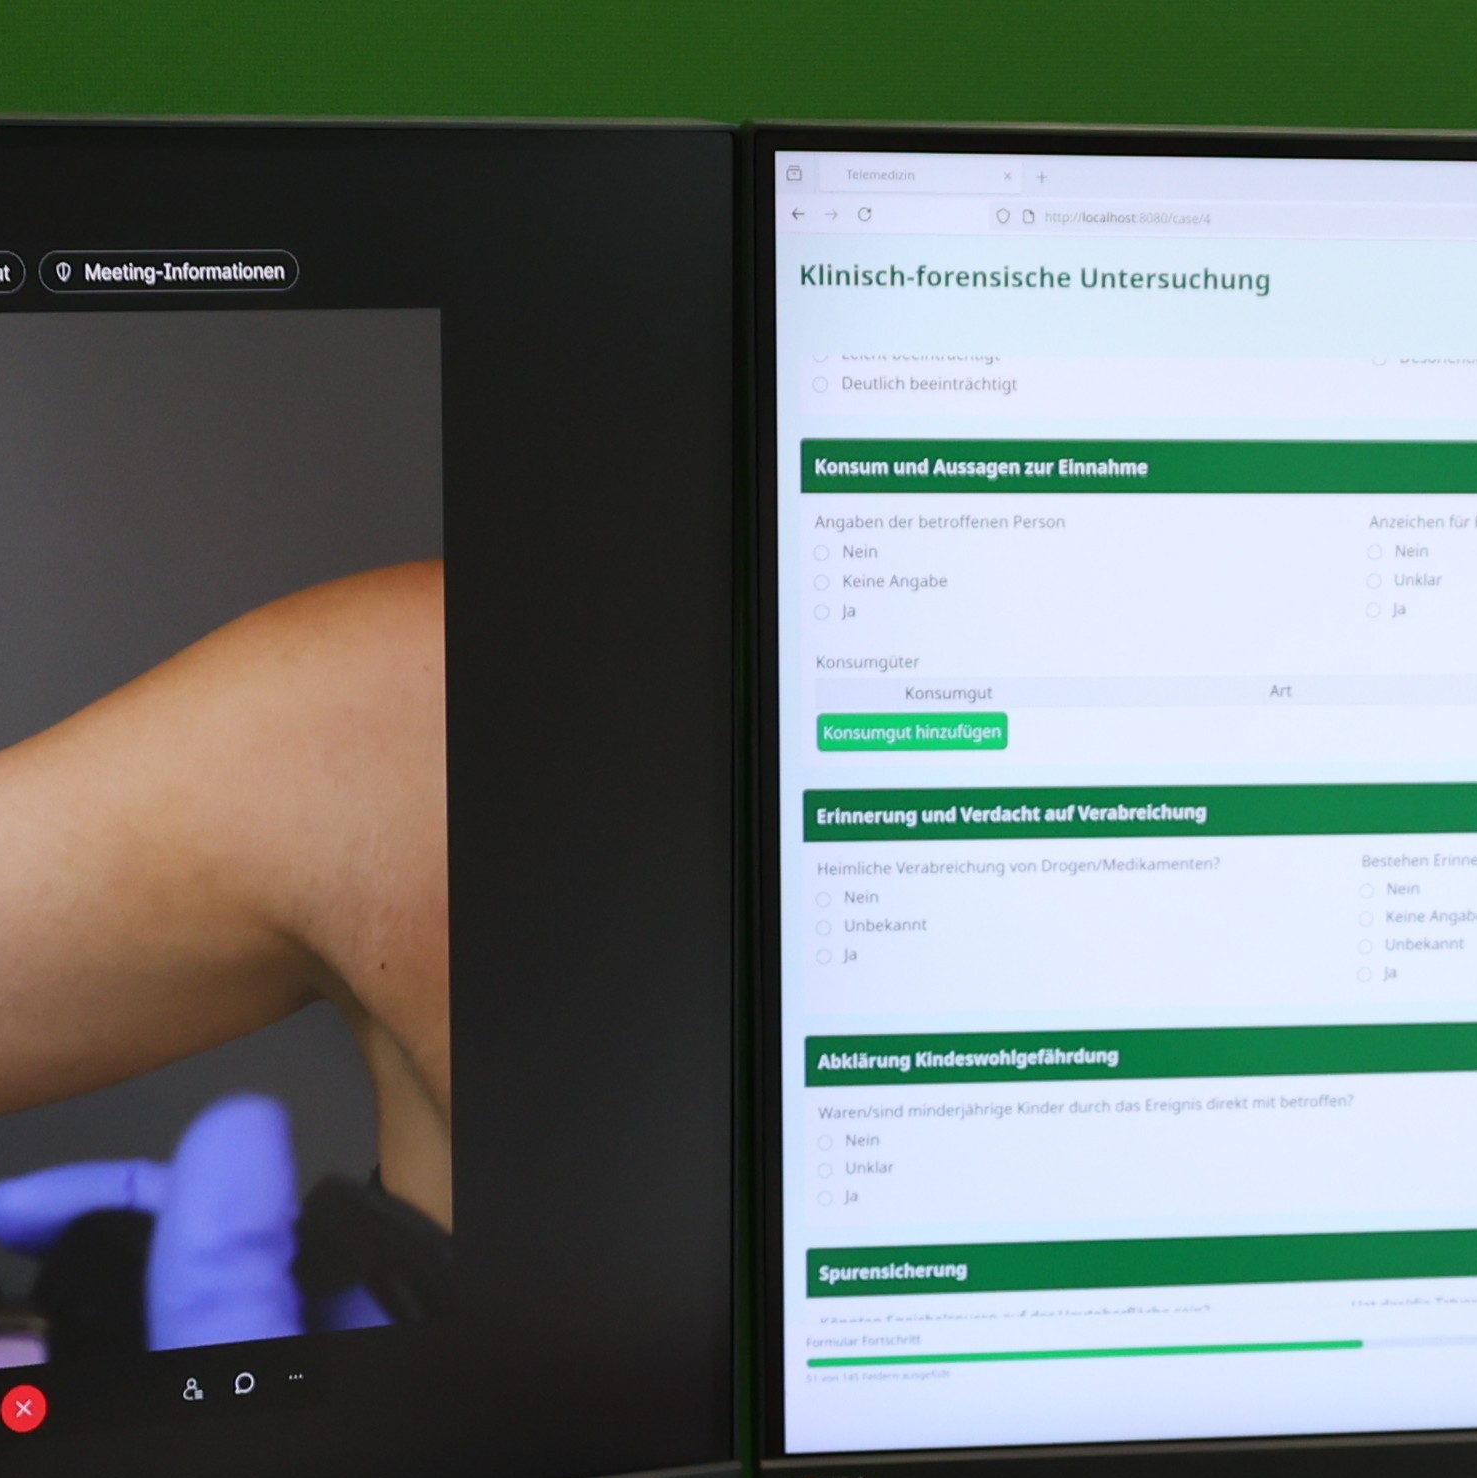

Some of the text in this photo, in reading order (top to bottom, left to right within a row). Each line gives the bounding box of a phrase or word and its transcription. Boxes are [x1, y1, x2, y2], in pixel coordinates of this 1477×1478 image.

[845, 168, 916, 181] Telemedizin
[1044, 211, 1211, 225] http://localhost:8080/case/4
[84, 261, 286, 285] Meeting-Informationen
[800, 263, 1270, 297] Klinisch-forensische Untersuchung
[841, 375, 1017, 396] Deutlich beeinträchtigt
[814, 457, 1149, 480] Konsum und Aussagen zur Einnahme
[814, 514, 1066, 533] Angaben der betroffenen Person
[1368, 514, 1445, 529] Anzeichen
[1448, 513, 1471, 529] für
[842, 544, 878, 559] Nein
[842, 574, 948, 592] Keine Angabe
[1394, 573, 1443, 587] Unklar
[841, 604, 856, 621] Ja
[815, 655, 920, 673] Konsumgüter
[905, 686, 993, 704] Konsumgut
[1269, 684, 1292, 697] Art
[823, 723, 1002, 745] Konsumgut hinzufügen
[816, 803, 1208, 828] Erinnerung und Verdacht auf Verabreichung
[817, 856, 1221, 878] Heimliche Verabreichung von Drogen/Medikamenten?
[1361, 854, 1430, 869] Bestehen
[844, 890, 879, 904] Nein
[844, 918, 927, 933] Unbekannt
[1385, 911, 1426, 924] Keine
[1385, 937, 1465, 952] Unbekannt
[842, 948, 858, 964] Ja
[817, 1047, 1120, 1073] Abklärung Kindeswohlgefährdung
[817, 1093, 1355, 1121] Waren/sind minderjährige Kinder durch das Ereignis direkt mit betroffen?
[845, 1133, 880, 1147] Nein
[845, 1160, 894, 1176] Unklar
[843, 1189, 859, 1206] Ja
[818, 1262, 968, 1286] Spurensicherung
